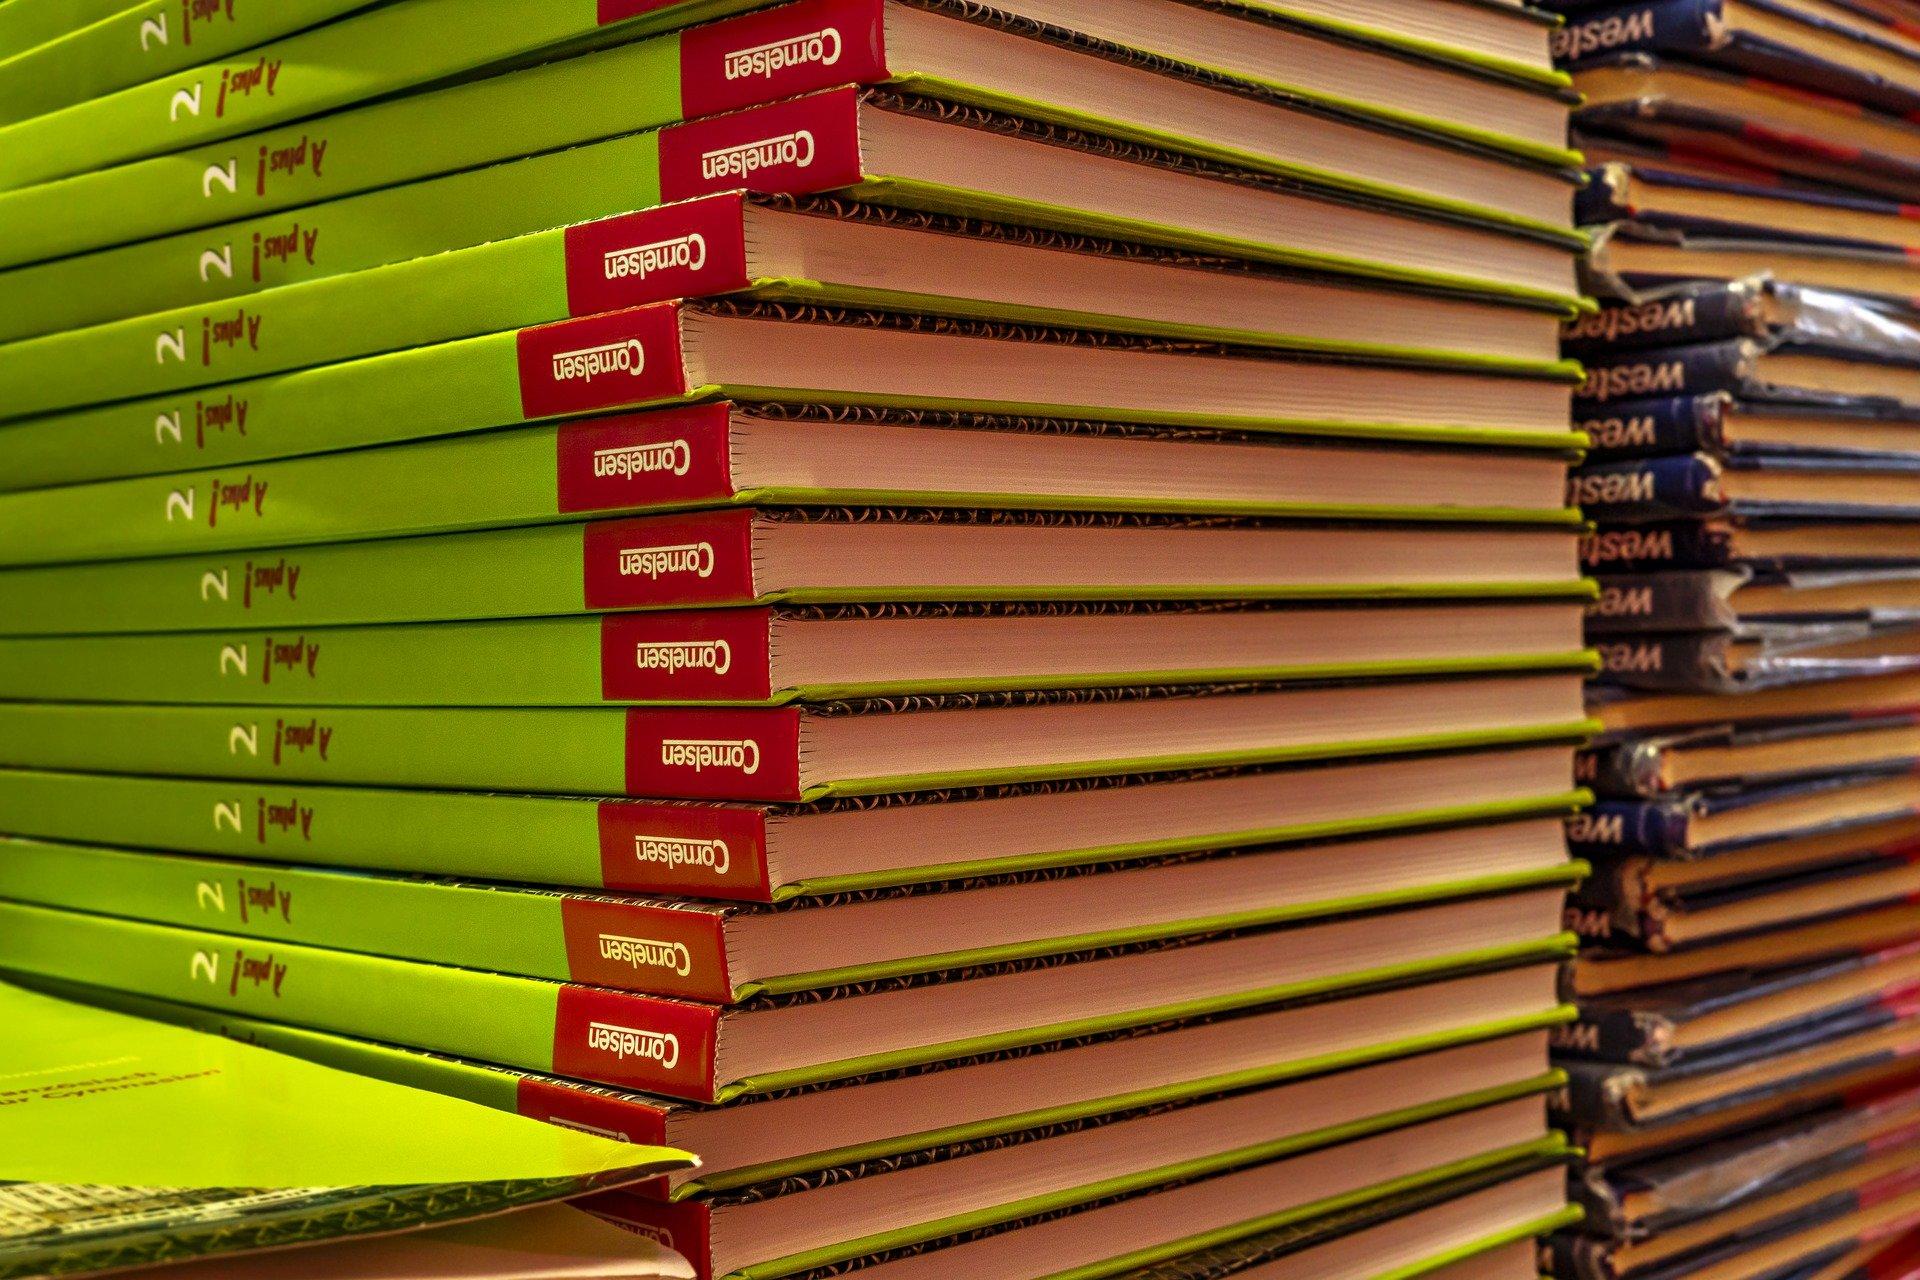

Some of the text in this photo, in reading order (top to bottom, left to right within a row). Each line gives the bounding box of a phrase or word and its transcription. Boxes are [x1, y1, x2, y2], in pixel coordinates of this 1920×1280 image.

[141, 12, 168, 50] 2
[725, 28, 841, 80] Cornelsen
[171, 82, 202, 122] 2
[702, 130, 814, 180] Cornelsen
[203, 158, 237, 198] 2
[200, 244, 233, 282] 2
[604, 234, 706, 280] Cornelsen
[156, 328, 186, 364] 2
[552, 339, 645, 383] Cornelsen
[155, 410, 183, 443] 2
[594, 440, 691, 480] Cornelsen
[167, 488, 195, 521] 2
[619, 542, 715, 580] Cornelsen
[201, 569, 229, 601] 2
[220, 644, 248, 676] 2
[637, 640, 731, 675] Cornelsen
[229, 724, 258, 756] 2
[662, 739, 760, 775] Cornelsen
[213, 802, 242, 833] 2
[635, 835, 730, 875] Cornelsen
[197, 882, 226, 912] 2
[191, 951, 219, 983] 2
[599, 934, 691, 977] Cornelsen
[588, 1021, 679, 1070] Cornelsen
